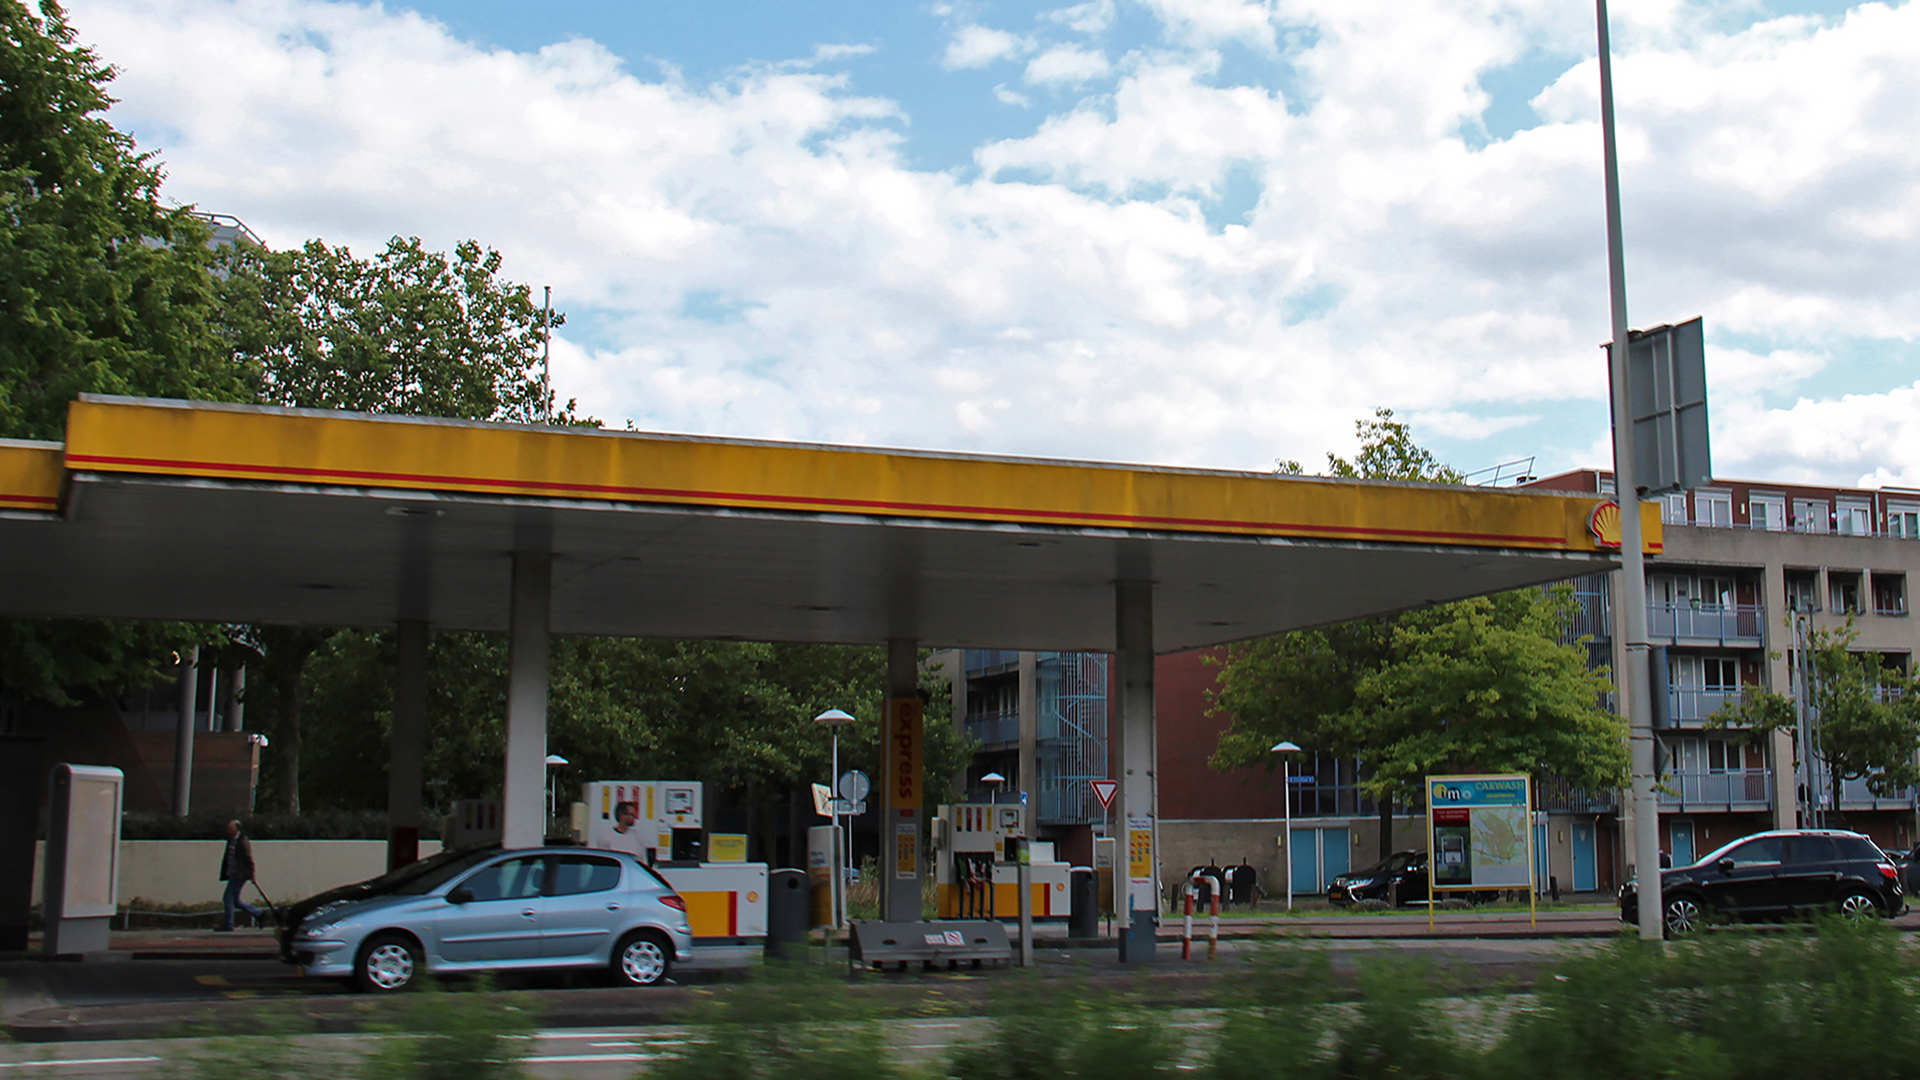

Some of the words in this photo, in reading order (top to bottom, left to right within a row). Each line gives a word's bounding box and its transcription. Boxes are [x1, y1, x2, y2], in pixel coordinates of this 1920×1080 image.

[894, 702, 913, 799] express
[1438, 785, 1472, 801] imo
[1475, 781, 1524, 791] CARWASH
